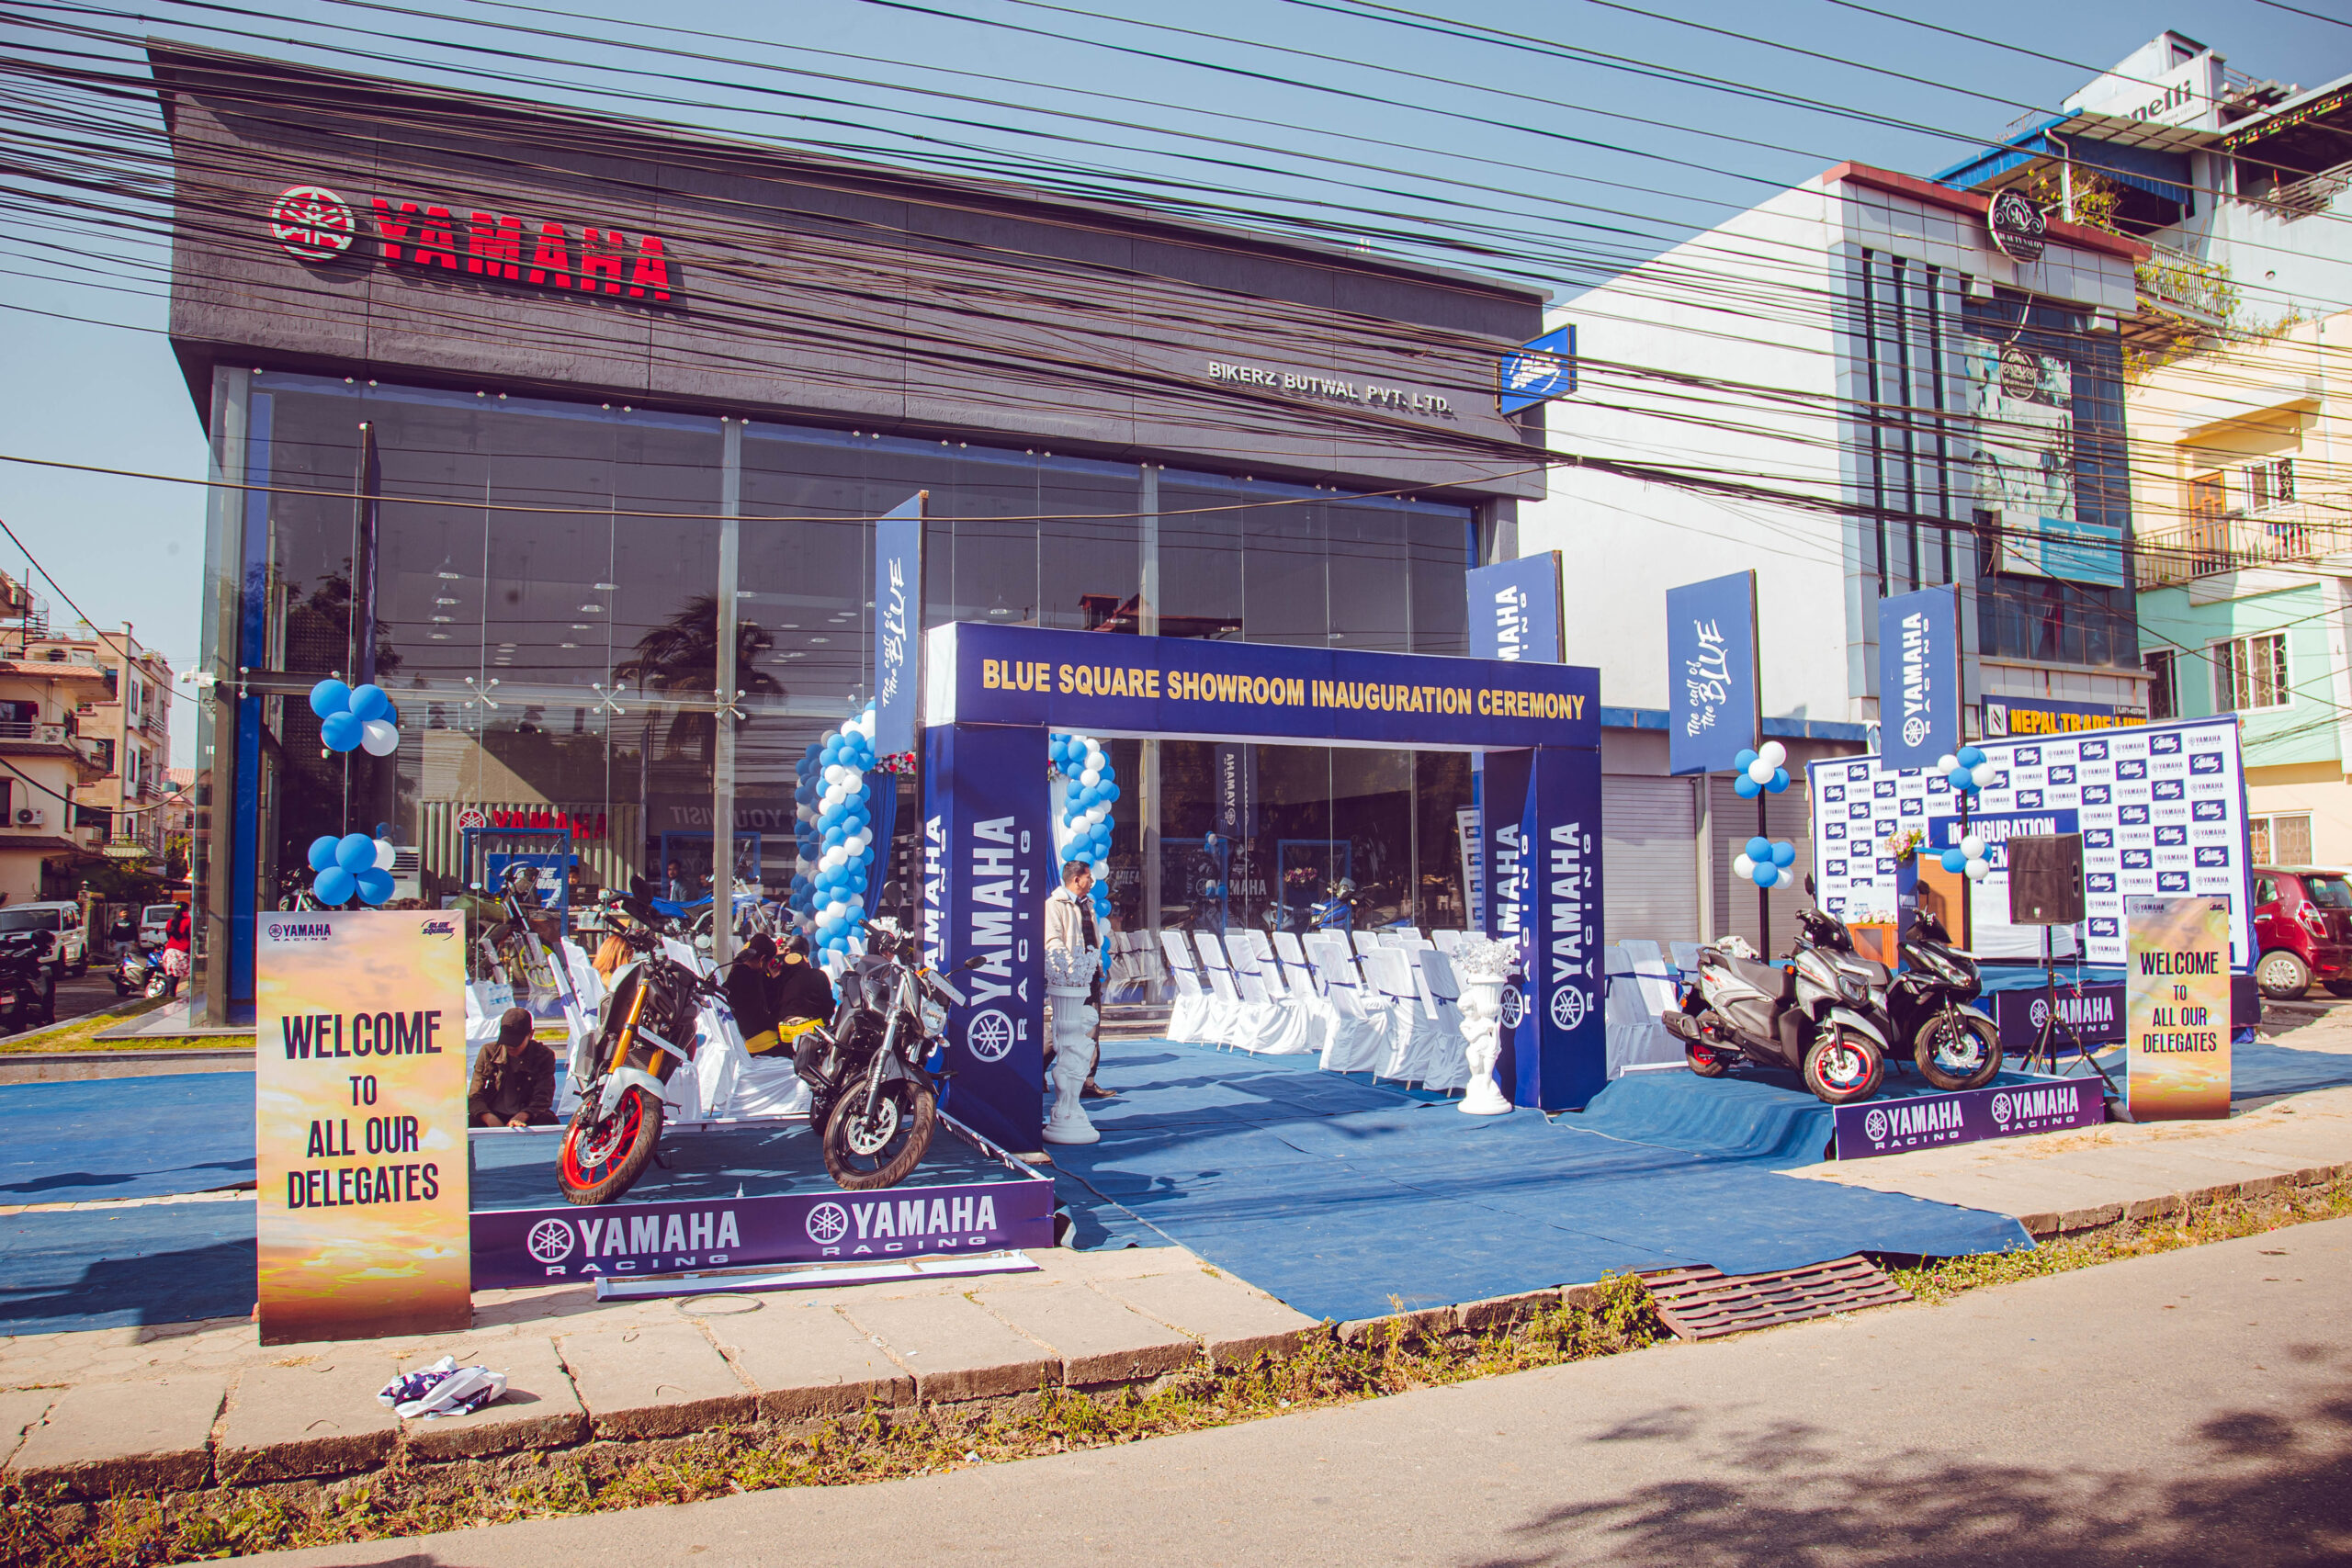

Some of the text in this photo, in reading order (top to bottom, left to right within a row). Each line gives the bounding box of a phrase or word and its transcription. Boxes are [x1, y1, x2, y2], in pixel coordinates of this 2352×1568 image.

[2120, 79, 2190, 120] nelli
[371, 198, 671, 300] YAMAHA
[1209, 361, 1453, 413] BIKERZ BUTWAL PVT. LTD.
[1496, 584, 1519, 661] MAHA
[1686, 660, 1702, 676] of
[1694, 618, 1732, 705] BLUE
[1902, 612, 1923, 718] YAMAHA
[983, 659, 1585, 720] BLUE SQUARE SHOWROOM INAUGURATION CEREMONY
[1687, 677, 1699, 707] call
[2010, 708, 2060, 734] NEPAL
[2060, 713, 2112, 733] TRADE
[492, 810, 606, 839] YAMAHA
[924, 815, 941, 971] AMAHA
[971, 816, 1015, 1007] YAMAHA
[1550, 822, 1581, 983] YAMAHA
[283, 924, 331, 936] YAMAHA
[1016, 829, 1030, 1042] RACING
[1521, 834, 1532, 1014] RACING
[1584, 833, 1594, 1011] RACING
[2141, 952, 2219, 976] WELCOME
[2173, 985, 2188, 1000] TO
[282, 1010, 442, 1059] WELCOME
[2153, 1007, 2208, 1027] ALL OUR
[2143, 1032, 2217, 1053] DELEGATES
[349, 1075, 378, 1106] TO
[2011, 1086, 2079, 1119] YAMAHA
[307, 1115, 419, 1157] ALL OUR
[1887, 1100, 1963, 1136] YAMAHA
[2000, 1115, 2075, 1132] RACING
[1875, 1131, 1959, 1151] RACING
[288, 1163, 439, 1209] DELEGATES
[578, 1210, 741, 1258] YAMAHA
[851, 1195, 998, 1239] YAMAHA
[546, 1253, 729, 1276] RACING
[821, 1235, 987, 1257] RACING
